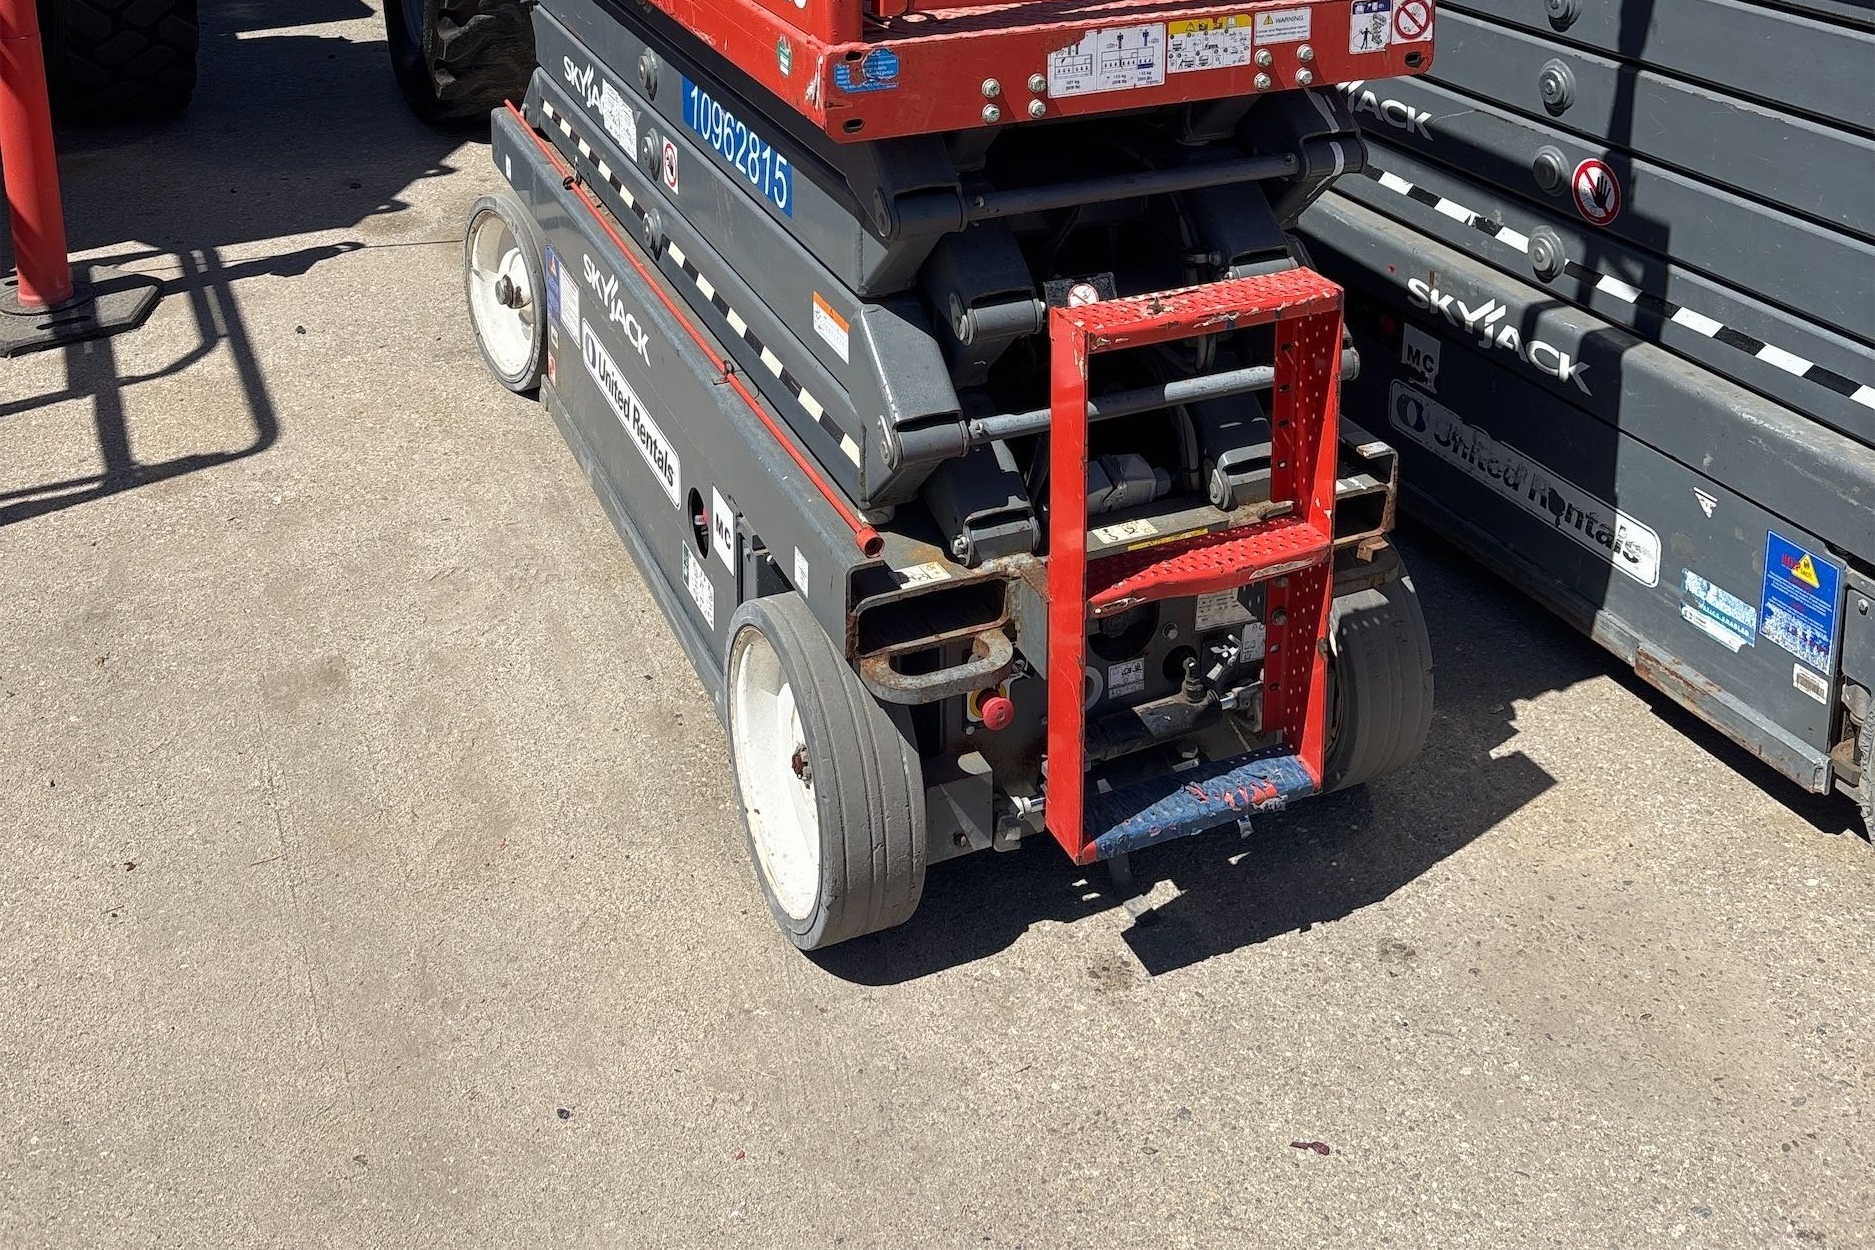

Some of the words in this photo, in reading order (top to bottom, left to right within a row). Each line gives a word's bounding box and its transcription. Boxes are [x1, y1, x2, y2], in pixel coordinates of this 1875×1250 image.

[1275, 15, 1304, 24] WARNING
[563, 56, 604, 115] SKYJA
[1336, 80, 1434, 141] JACK
[691, 85, 788, 209] 10962815
[583, 253, 651, 367] SKYJACK
[1407, 278, 1592, 397] SKYJACK
[1407, 345, 1435, 374] MC
[600, 352, 630, 422] United
[633, 402, 674, 487] Rentals
[715, 512, 731, 550] MC
